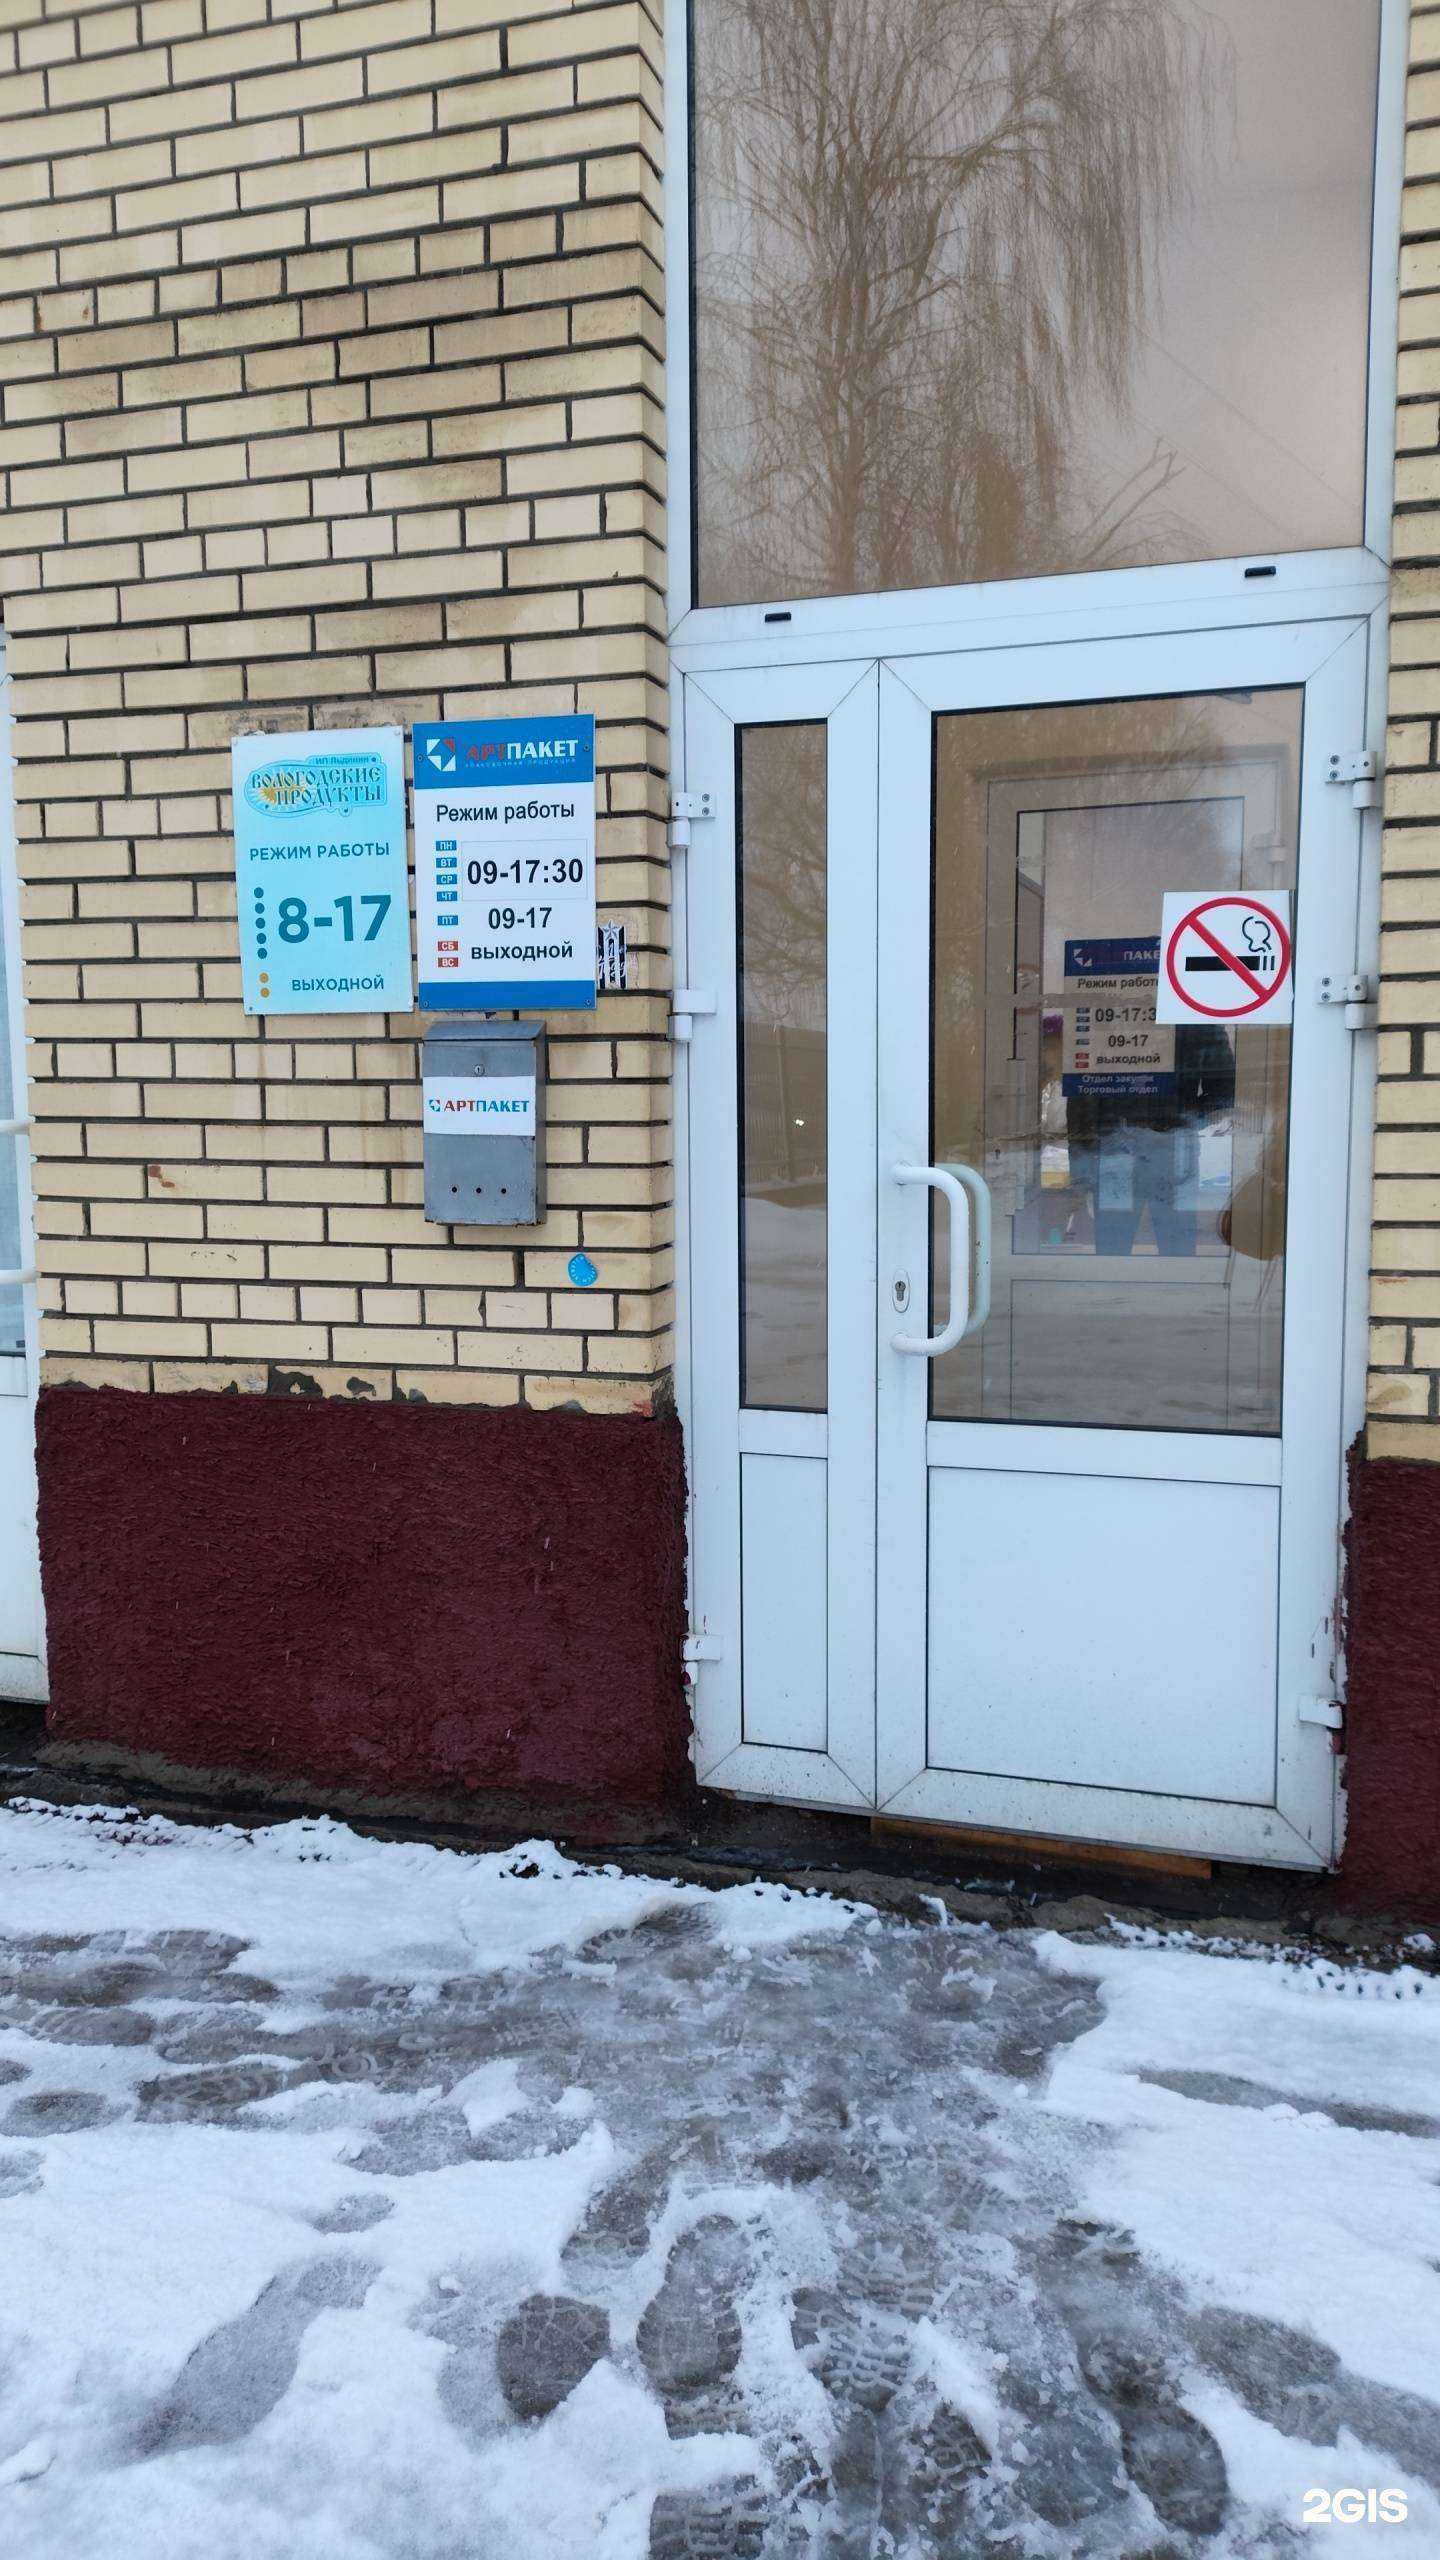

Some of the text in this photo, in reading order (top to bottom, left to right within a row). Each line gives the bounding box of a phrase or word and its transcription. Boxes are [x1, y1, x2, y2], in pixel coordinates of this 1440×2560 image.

[465, 739, 579, 760] АРТПАКЕТ
[252, 767, 381, 789] ВОЛОГОДСКИЕ
[275, 785, 381, 807] ПРОДУКТЫ
[436, 800, 575, 824] Режим работы
[250, 842, 390, 861] РЕЖИМ РАБОТЫ
[440, 841, 453, 850] ПН
[440, 858, 452, 867] ВТ
[467, 858, 583, 885] 09-17:30
[440, 875, 453, 884] СР
[441, 892, 452, 901] ЧТ
[278, 894, 392, 943] 8-17
[442, 916, 453, 925] ПТ
[488, 907, 552, 930] 09-17
[441, 941, 454, 950] СБ
[471, 941, 573, 961] выходной
[442, 958, 454, 967] ВС
[291, 974, 384, 992] ВЫХОДНОЙ
[1078, 978, 1116, 989] Режим
[1095, 1008, 1156, 1022] 09-17:3
[1108, 1035, 1148, 1047] 09-17
[1078, 1085, 1126, 1094] Торговый
[444, 1100, 529, 1112] АРТПАКЕТ
